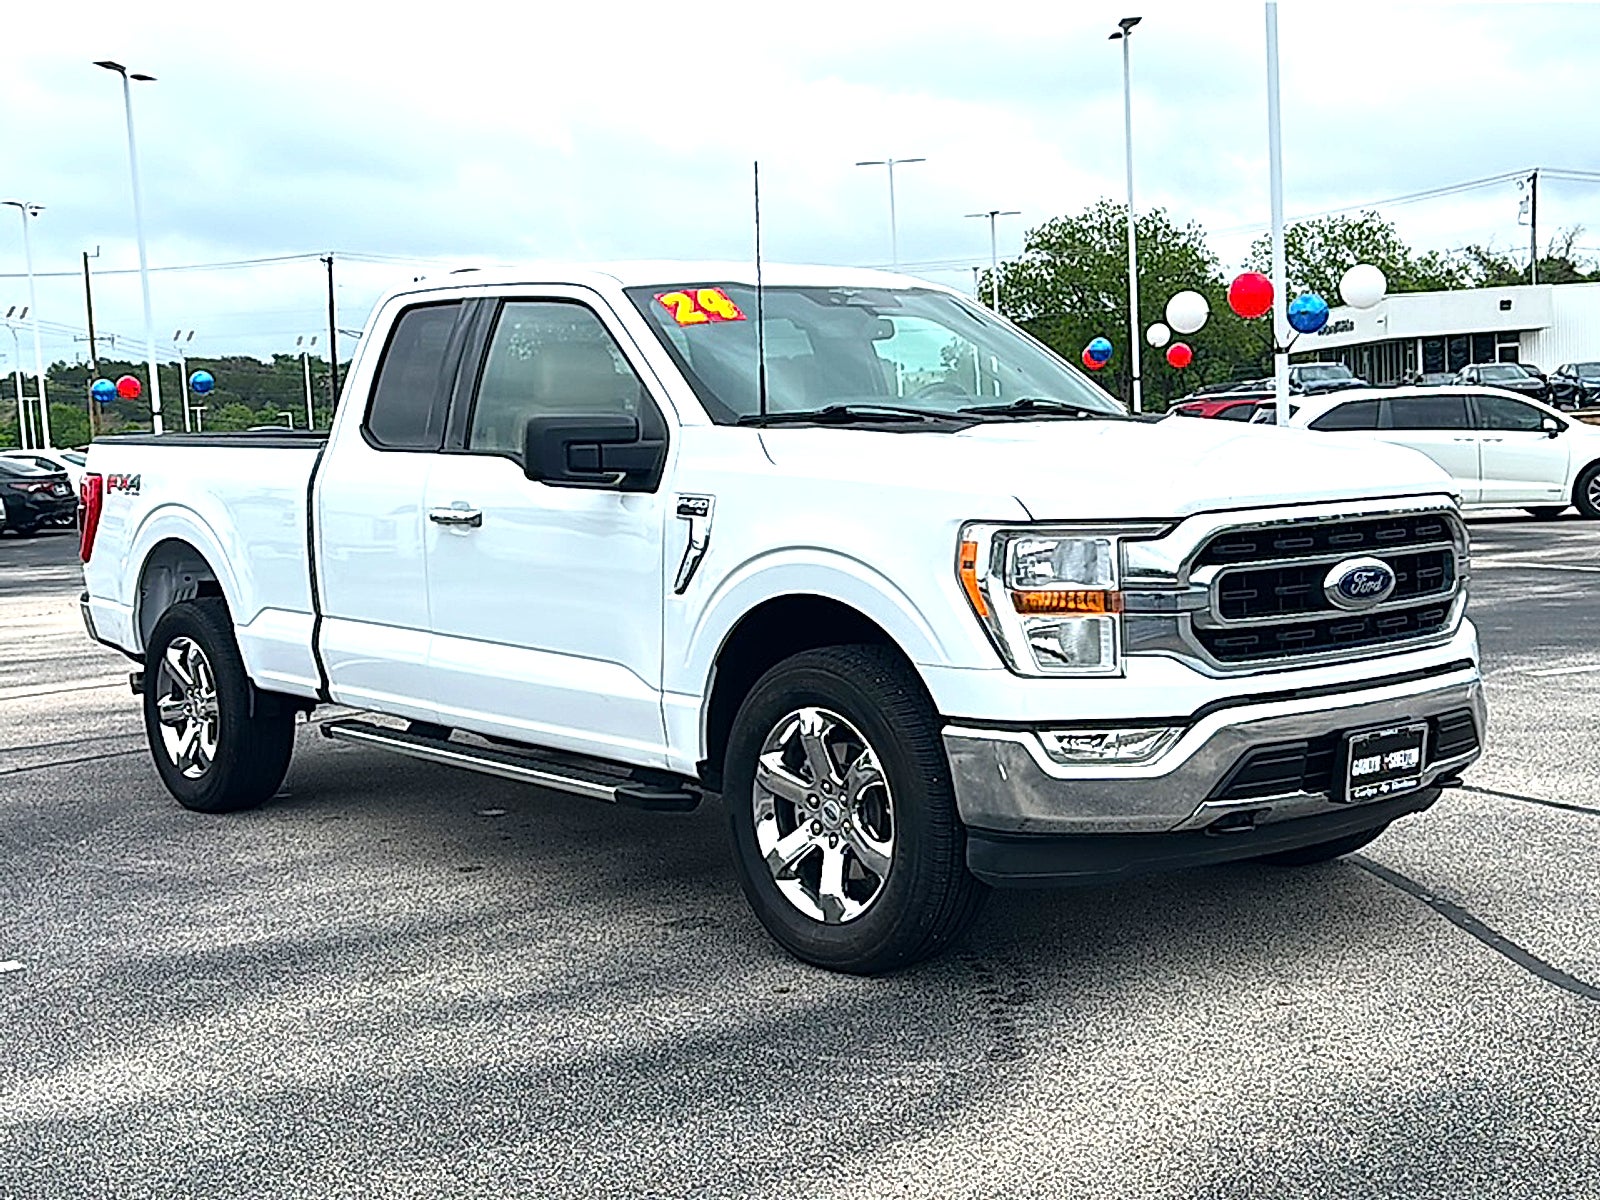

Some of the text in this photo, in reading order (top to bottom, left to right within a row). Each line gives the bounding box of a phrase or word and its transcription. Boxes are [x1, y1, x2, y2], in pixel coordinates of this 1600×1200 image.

[660, 288, 738, 324] 24
[107, 474, 141, 494] FX4
[1351, 572, 1384, 595] Ford
